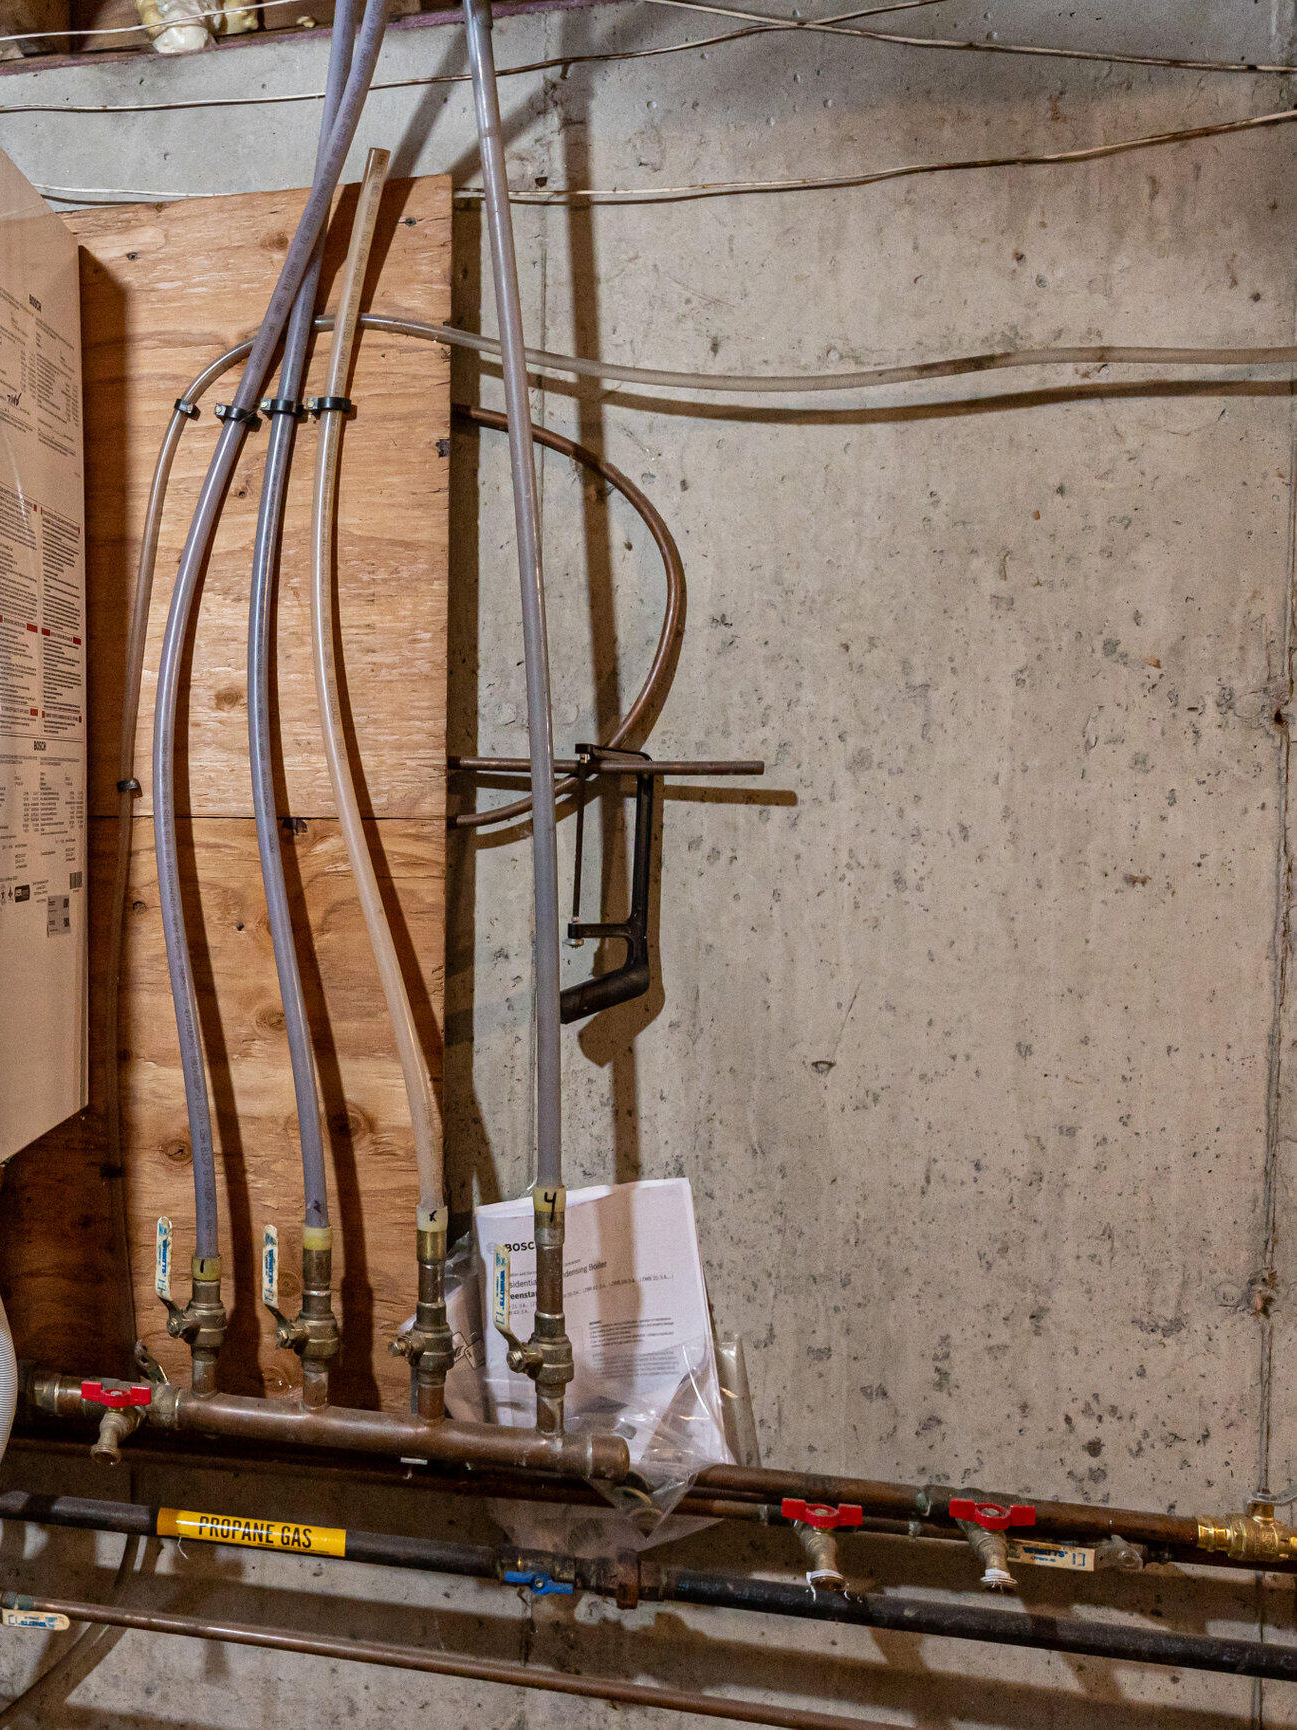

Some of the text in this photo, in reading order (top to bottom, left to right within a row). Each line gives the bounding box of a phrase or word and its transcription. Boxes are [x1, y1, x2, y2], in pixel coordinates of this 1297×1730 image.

[33, 741, 47, 751] BOSCH
[544, 1191, 557, 1222] 4
[505, 1241, 536, 1252] BOSC
[588, 1260, 608, 1271] Boiler
[198, 1515, 275, 1545] PROPANE
[280, 1525, 312, 1549] GAS
[1022, 1547, 1066, 1558] WATTS
